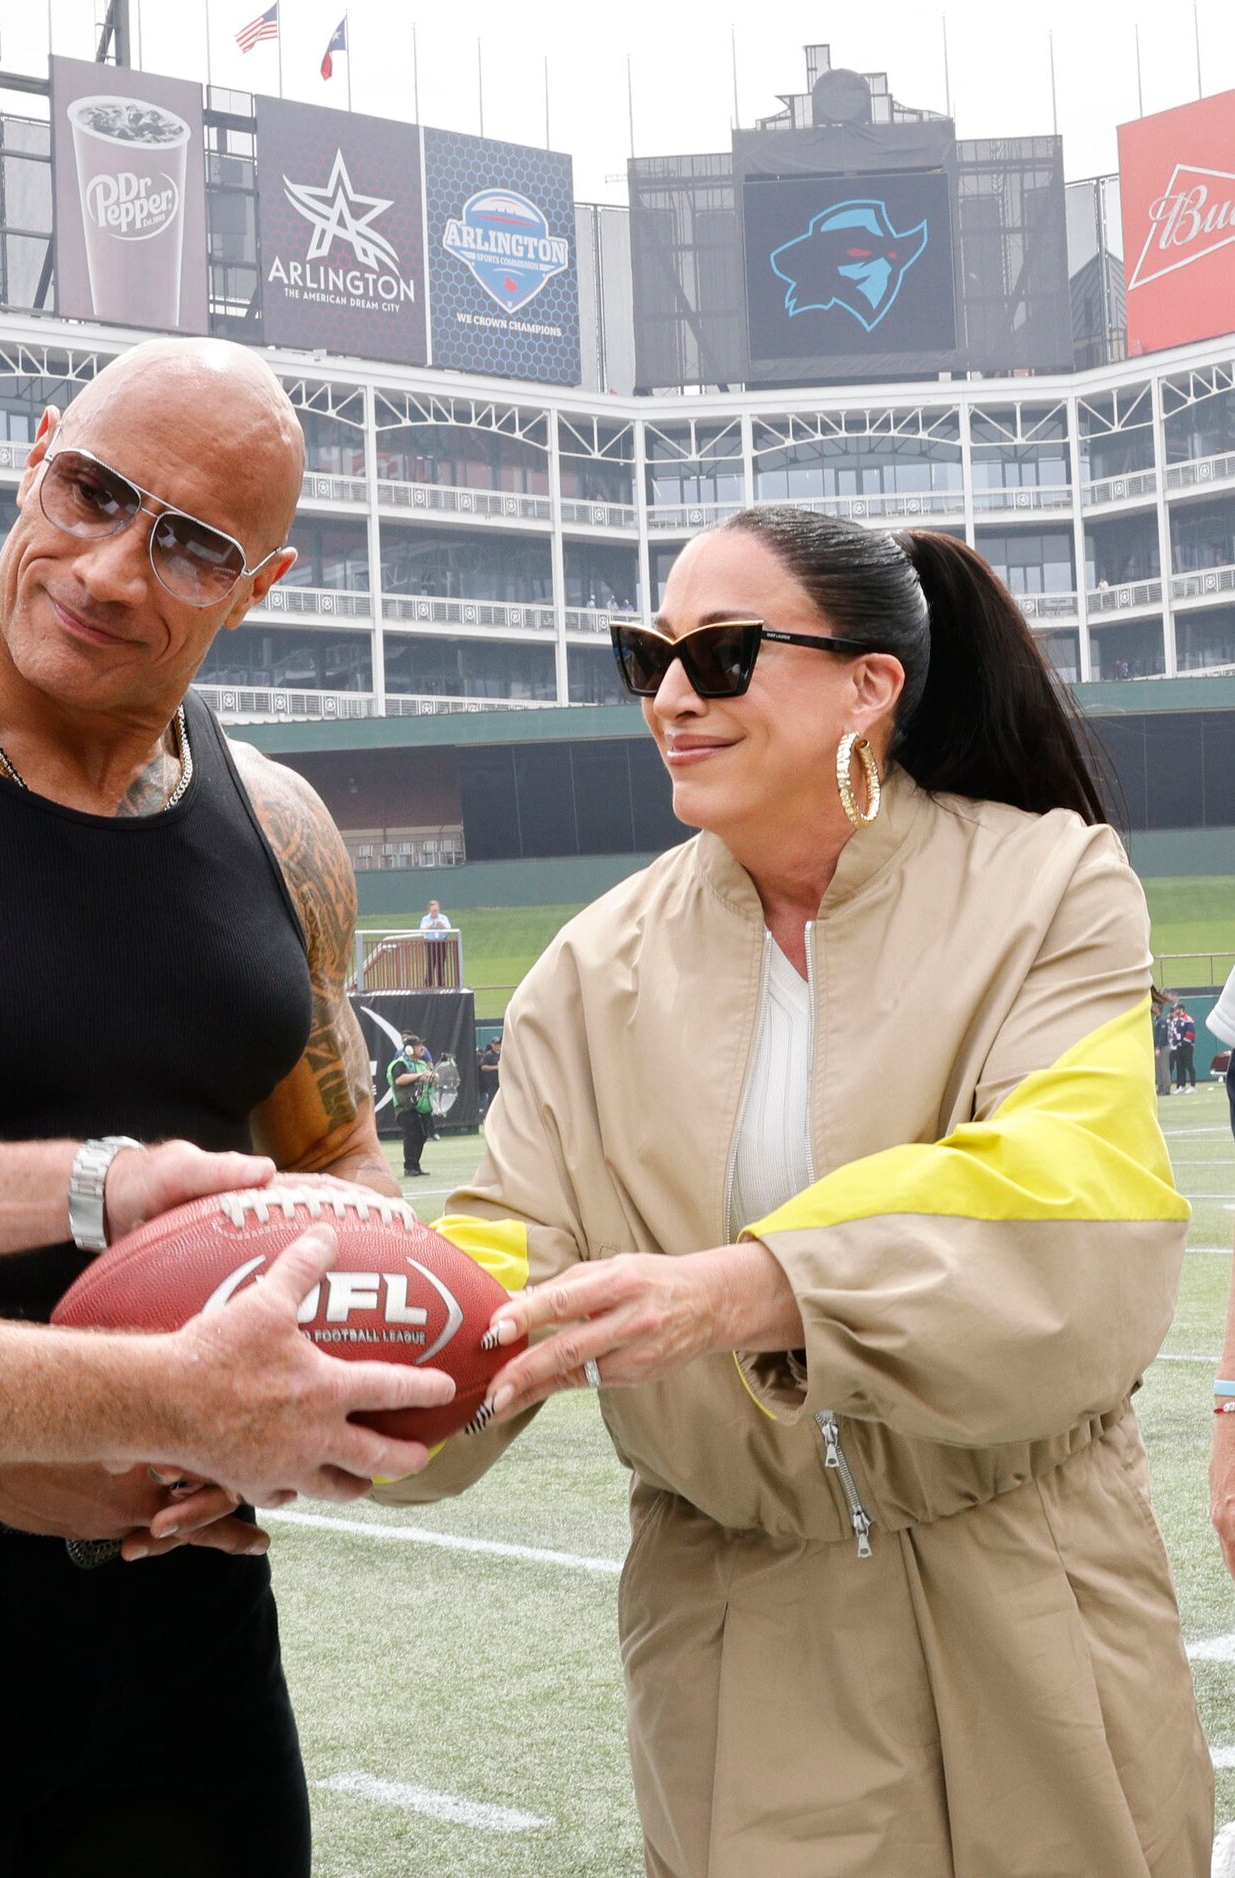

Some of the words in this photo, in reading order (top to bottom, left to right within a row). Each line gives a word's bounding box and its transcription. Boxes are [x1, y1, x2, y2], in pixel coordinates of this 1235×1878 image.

[117, 172, 152, 203] Dr
[86, 174, 173, 232] Pepper
[446, 223, 566, 264] ARLINGTON
[476, 254, 500, 265] SPORTS
[500, 256, 539, 271] COMMISSION
[267, 255, 415, 303] ARLINGTON
[284, 287, 300, 299] THE
[303, 291, 347, 305] AMERICAN
[350, 298, 379, 310] DREAM
[382, 302, 400, 313] CITY
[456, 313, 472, 324] WE
[473, 315, 507, 329] CROWN
[508, 319, 562, 337] CHAMPIONS
[316, 1328, 379, 1343] FOOTBALL
[382, 1329, 426, 1345] LEAGUE
